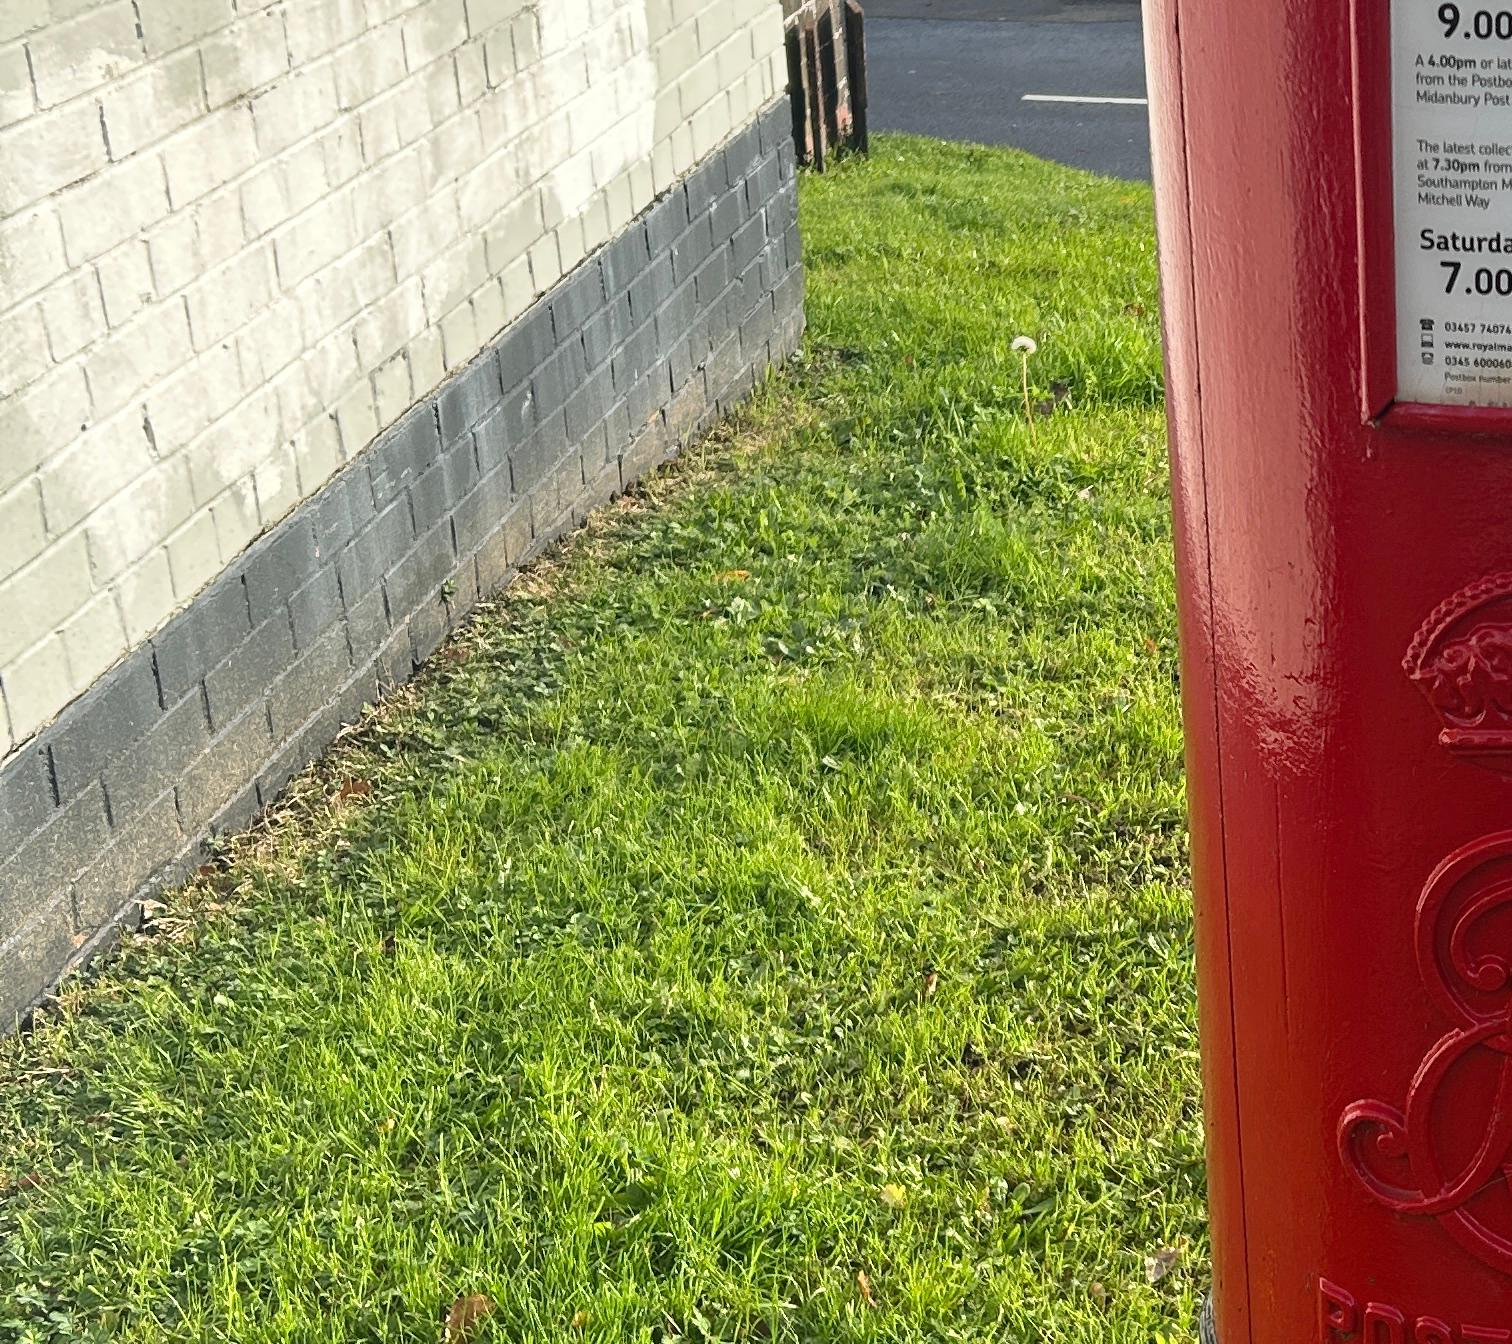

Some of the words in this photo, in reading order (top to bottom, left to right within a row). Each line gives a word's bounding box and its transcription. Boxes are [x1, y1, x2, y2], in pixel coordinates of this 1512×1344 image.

[1414, 53, 1425, 68] A
[1427, 54, 1477, 71] 4.00pm
[1480, 59, 1494, 71] or
[1415, 71, 1445, 86] from
[1448, 73, 1468, 87] the
[1416, 89, 1481, 108] Midanbury
[1484, 91, 1510, 107] Post
[1416, 139, 1440, 154] The
[1443, 141, 1476, 156] latest
[1416, 158, 1429, 171] at
[1432, 157, 1480, 174] 7.30pm
[1483, 159, 1512, 174] from
[1417, 174, 1498, 192] Southampton
[1417, 192, 1463, 207] Mitchell
[1464, 193, 1490, 210] Way
[1444, 321, 1476, 334] 03457
[1444, 355, 1470, 368] 0345
[1444, 372, 1477, 383] Postbox
